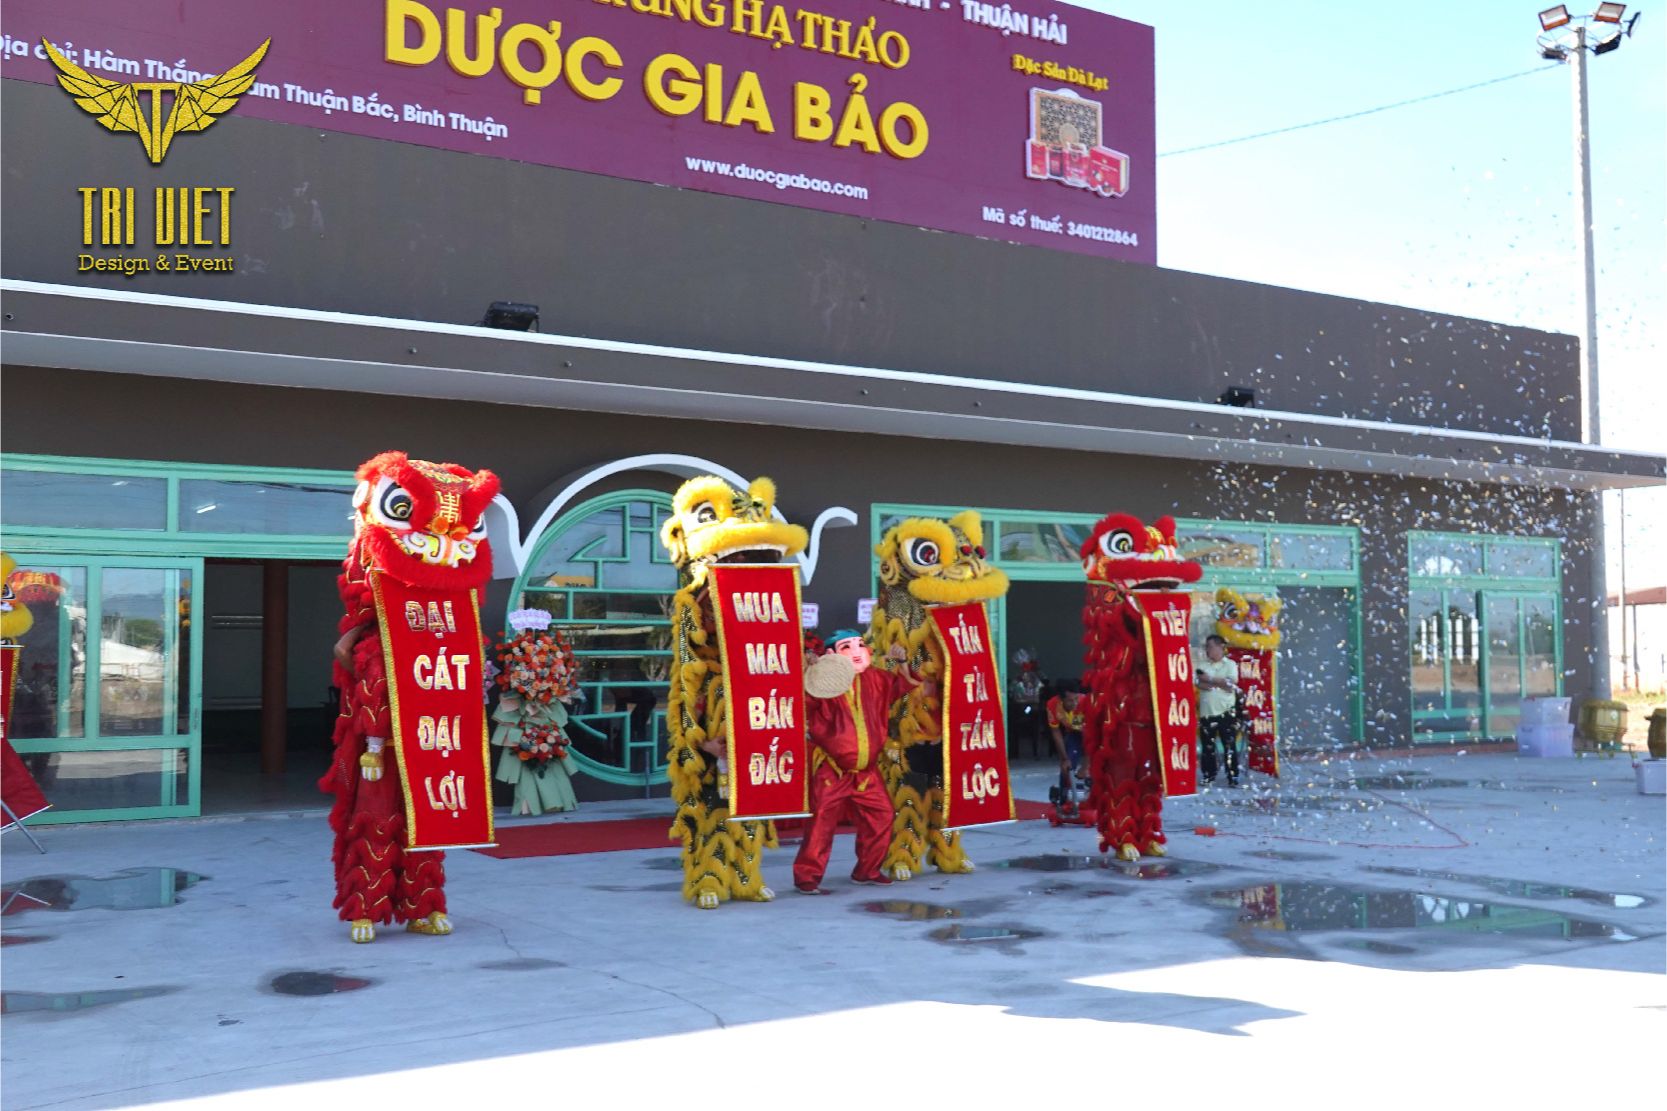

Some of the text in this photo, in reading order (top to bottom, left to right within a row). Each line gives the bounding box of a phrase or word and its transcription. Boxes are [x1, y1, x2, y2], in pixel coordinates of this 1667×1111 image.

[730, 0, 794, 49] HẠ
[796, 9, 911, 69] THẢO
[960, 0, 1029, 37] THUẬN
[1031, 13, 1068, 45] HẢI
[84, 49, 140, 75] Hàm
[284, 84, 349, 114] Thuận
[352, 92, 399, 122] Bắc,
[403, 103, 445, 128] Bình
[449, 112, 508, 141] Thuận
[384, 0, 929, 159] DƯỢC GIA BẢO
[685, 156, 868, 200] www.duocgiabao.com
[1009, 208, 1027, 227] số
[1030, 210, 1063, 234] thuế:
[405, 600, 456, 638] ĐẠI
[732, 592, 789, 623] MUA
[413, 646, 470, 690] CÁT
[745, 643, 790, 675] MAI
[1168, 692, 1190, 726] ÀO
[418, 715, 461, 758] ĐẠI
[424, 770, 468, 818] LỢI
[962, 763, 1000, 804] LỘC
